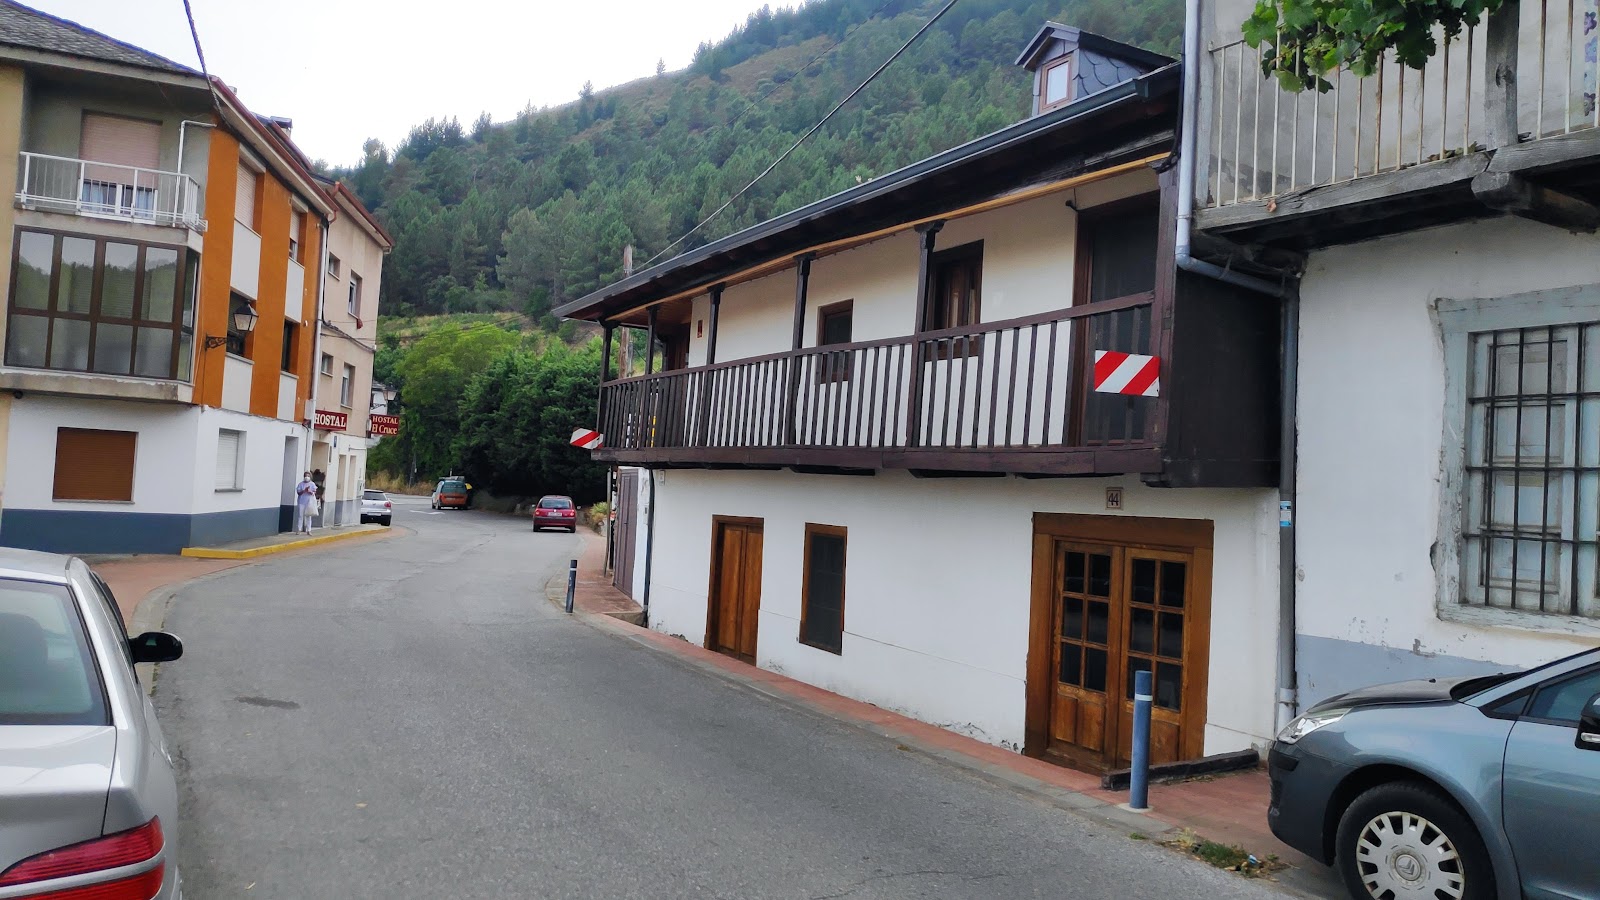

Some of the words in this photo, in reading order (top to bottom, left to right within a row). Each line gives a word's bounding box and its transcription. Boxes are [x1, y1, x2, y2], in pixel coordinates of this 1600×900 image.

[314, 414, 346, 427] HOSTAL
[372, 416, 398, 424] HOSTAL
[372, 424, 378, 432] El
[378, 424, 398, 434] Cruce
[1108, 492, 1119, 506] 44
